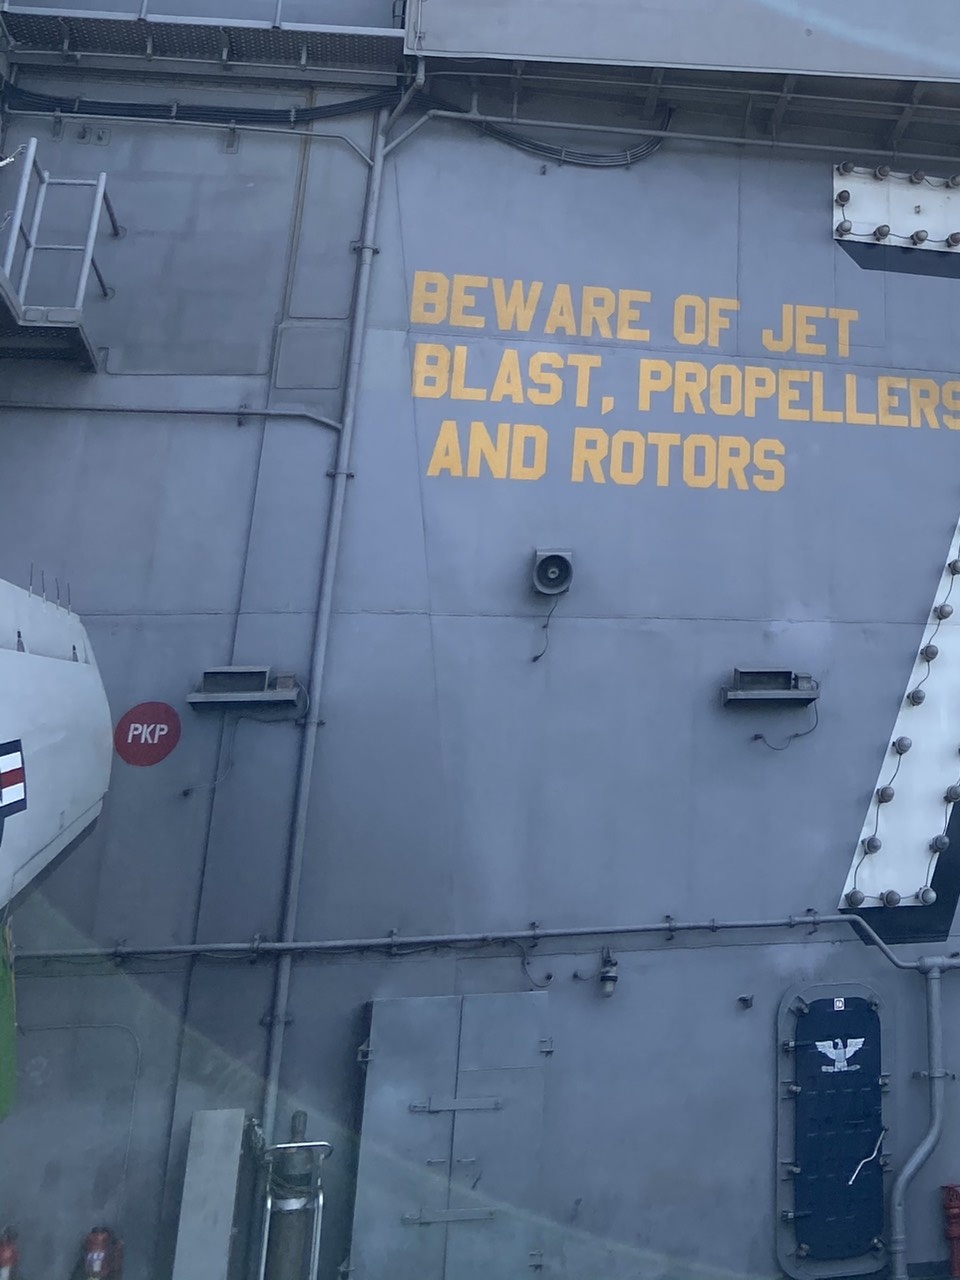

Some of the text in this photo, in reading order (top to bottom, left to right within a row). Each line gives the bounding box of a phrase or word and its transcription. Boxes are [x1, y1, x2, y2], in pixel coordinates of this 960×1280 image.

[410, 270, 859, 357] BEWARE OF JET
[411, 343, 614, 414] BLAST,
[427, 420, 786, 492] AND ROTORS
[127, 723, 169, 744] PKP
